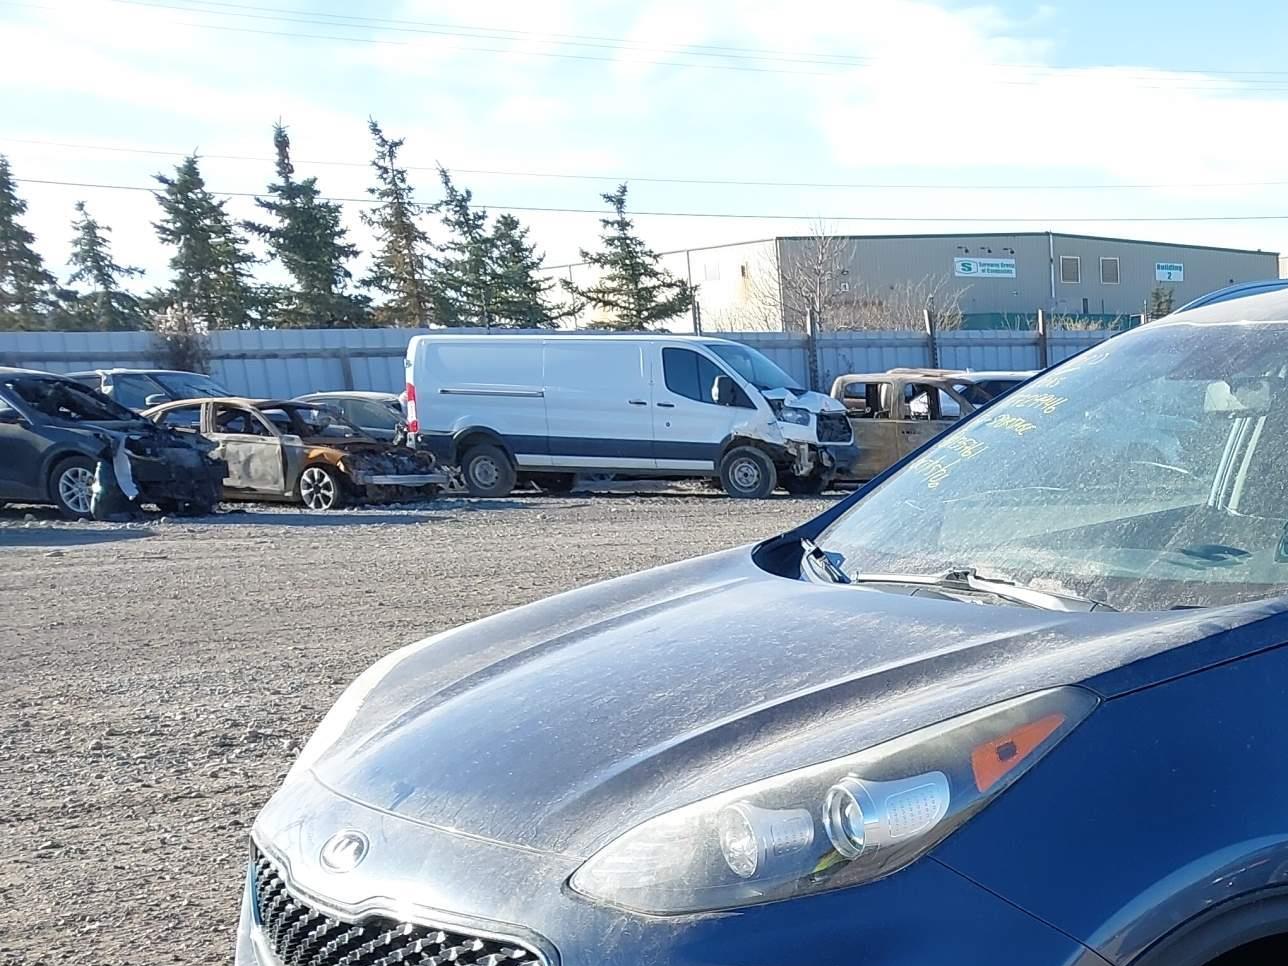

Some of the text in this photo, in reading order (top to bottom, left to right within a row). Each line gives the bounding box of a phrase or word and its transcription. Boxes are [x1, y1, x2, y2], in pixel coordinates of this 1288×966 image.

[961, 262, 972, 272] S
[1157, 263, 1182, 272] Building
[1167, 271, 1172, 280] 2
